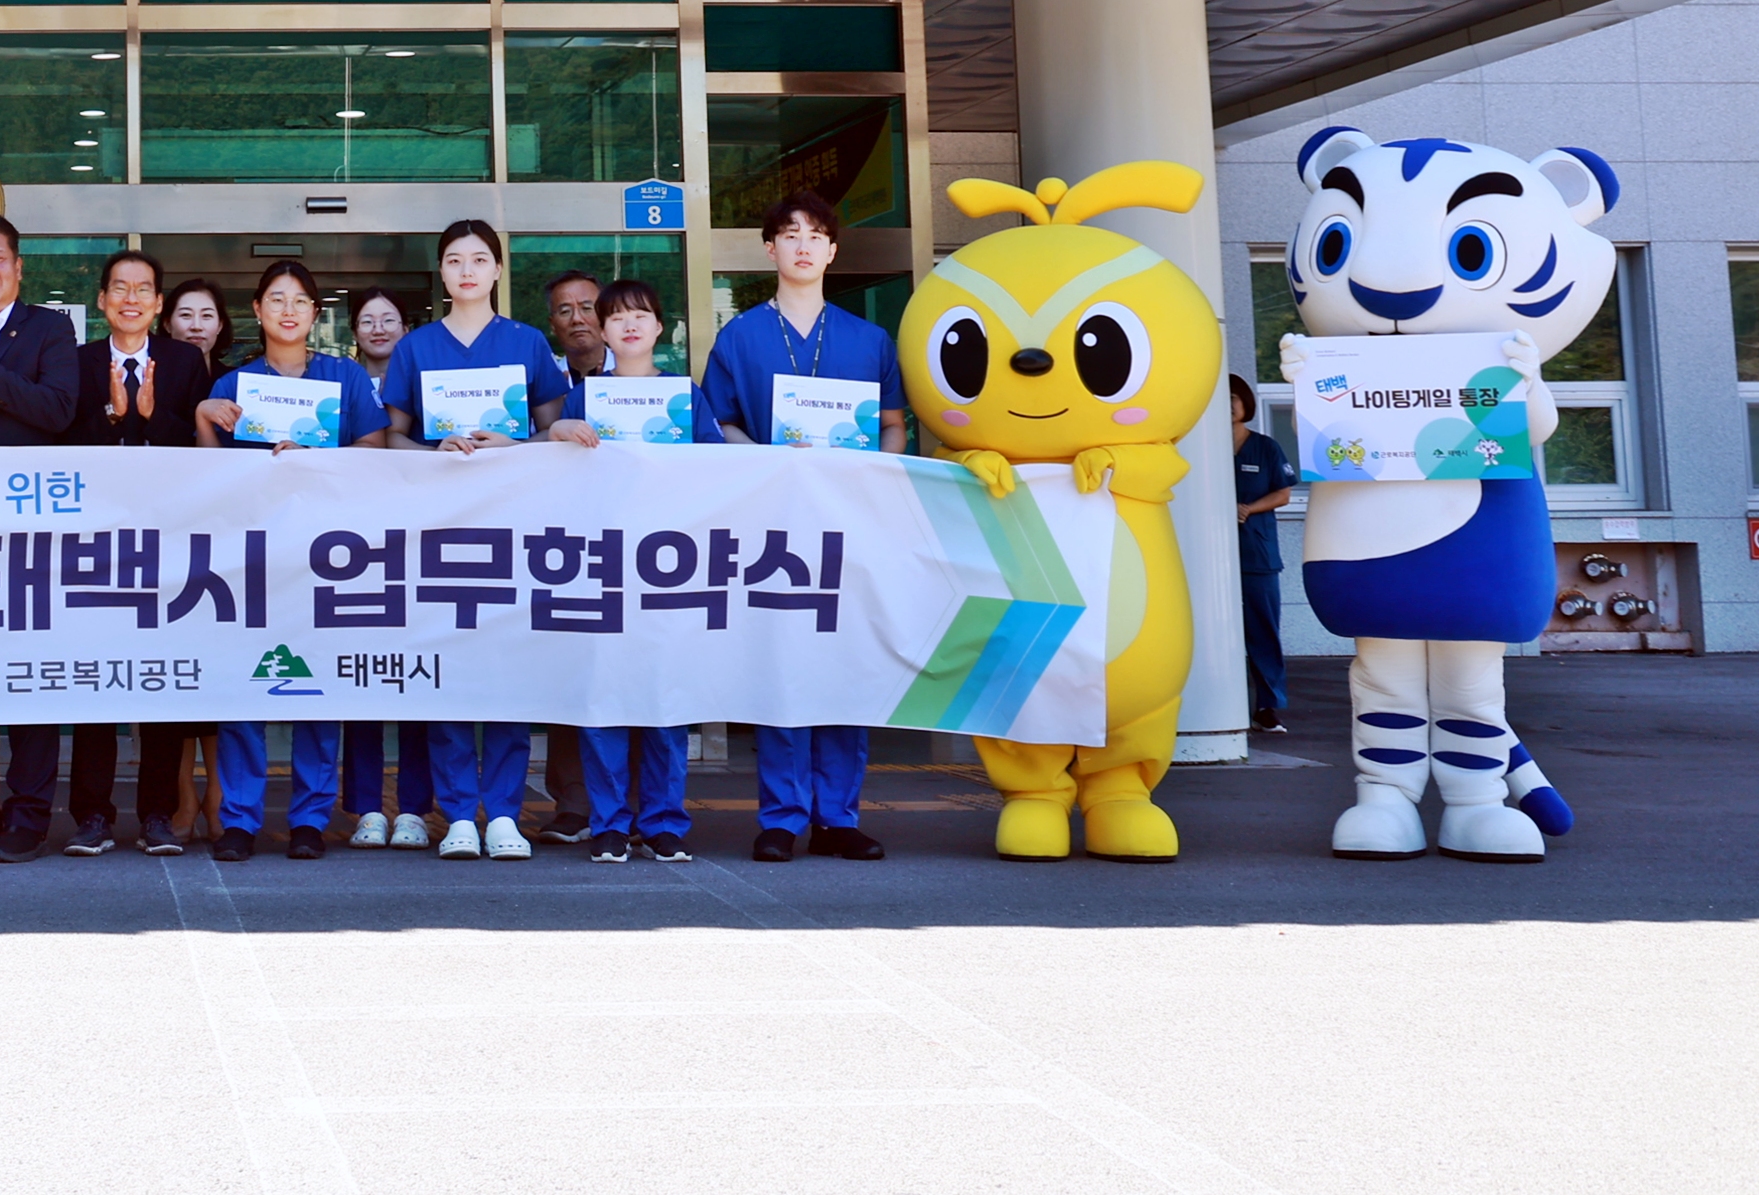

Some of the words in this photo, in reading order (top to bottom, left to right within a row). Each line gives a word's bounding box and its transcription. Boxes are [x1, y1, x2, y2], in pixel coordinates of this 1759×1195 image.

[648, 205, 662, 225] 8
[1315, 374, 1347, 394] 태백
[1351, 388, 1452, 409] 나이팅게일
[1458, 388, 1500, 408] 통장
[5, 472, 88, 517] 위한
[309, 527, 844, 635] 업무협약식
[5, 659, 203, 694] 근로복지공단
[337, 653, 441, 695] 태백시
